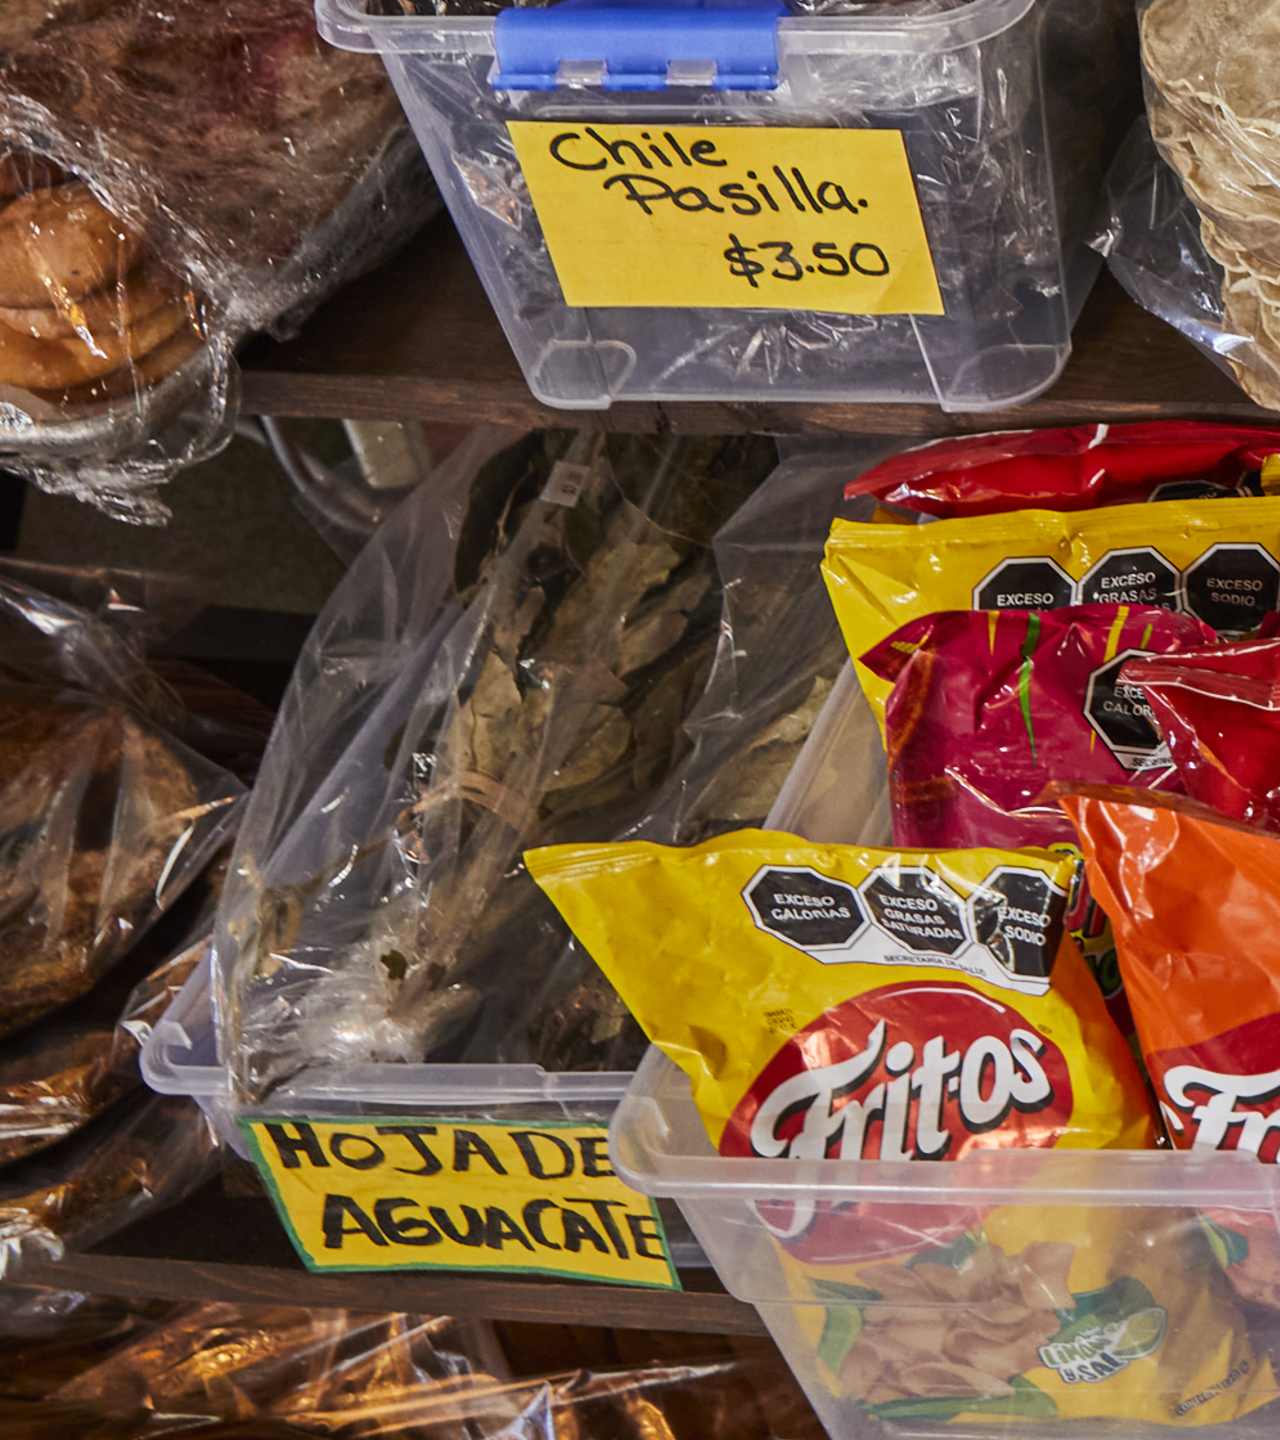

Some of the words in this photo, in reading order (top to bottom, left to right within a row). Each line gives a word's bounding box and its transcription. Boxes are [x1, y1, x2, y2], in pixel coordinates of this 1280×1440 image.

[549, 127, 727, 171] Chile
[603, 165, 869, 217] Pasilla.
[723, 234, 890, 288] $3.50
[1100, 571, 1156, 589] EXCESO
[1206, 577, 1263, 592] EXCESO
[996, 592, 1054, 607] EXCESO
[1211, 591, 1256, 606] SODIO
[1114, 686, 1144, 698] EXCE
[1103, 700, 1156, 717] CALOR
[774, 893, 836, 907] EXCESO
[880, 894, 938, 912] EXCESO
[885, 908, 945, 925] GRASAS
[1000, 907, 1050, 926] EXCESO
[882, 918, 963, 941] SATURADAS
[1004, 925, 1047, 946] SODIO
[750, 1020, 1062, 1165] Fritos
[263, 1120, 509, 1177] HOJA
[507, 1130, 618, 1180] DE
[321, 1193, 670, 1262] AGUACATE
